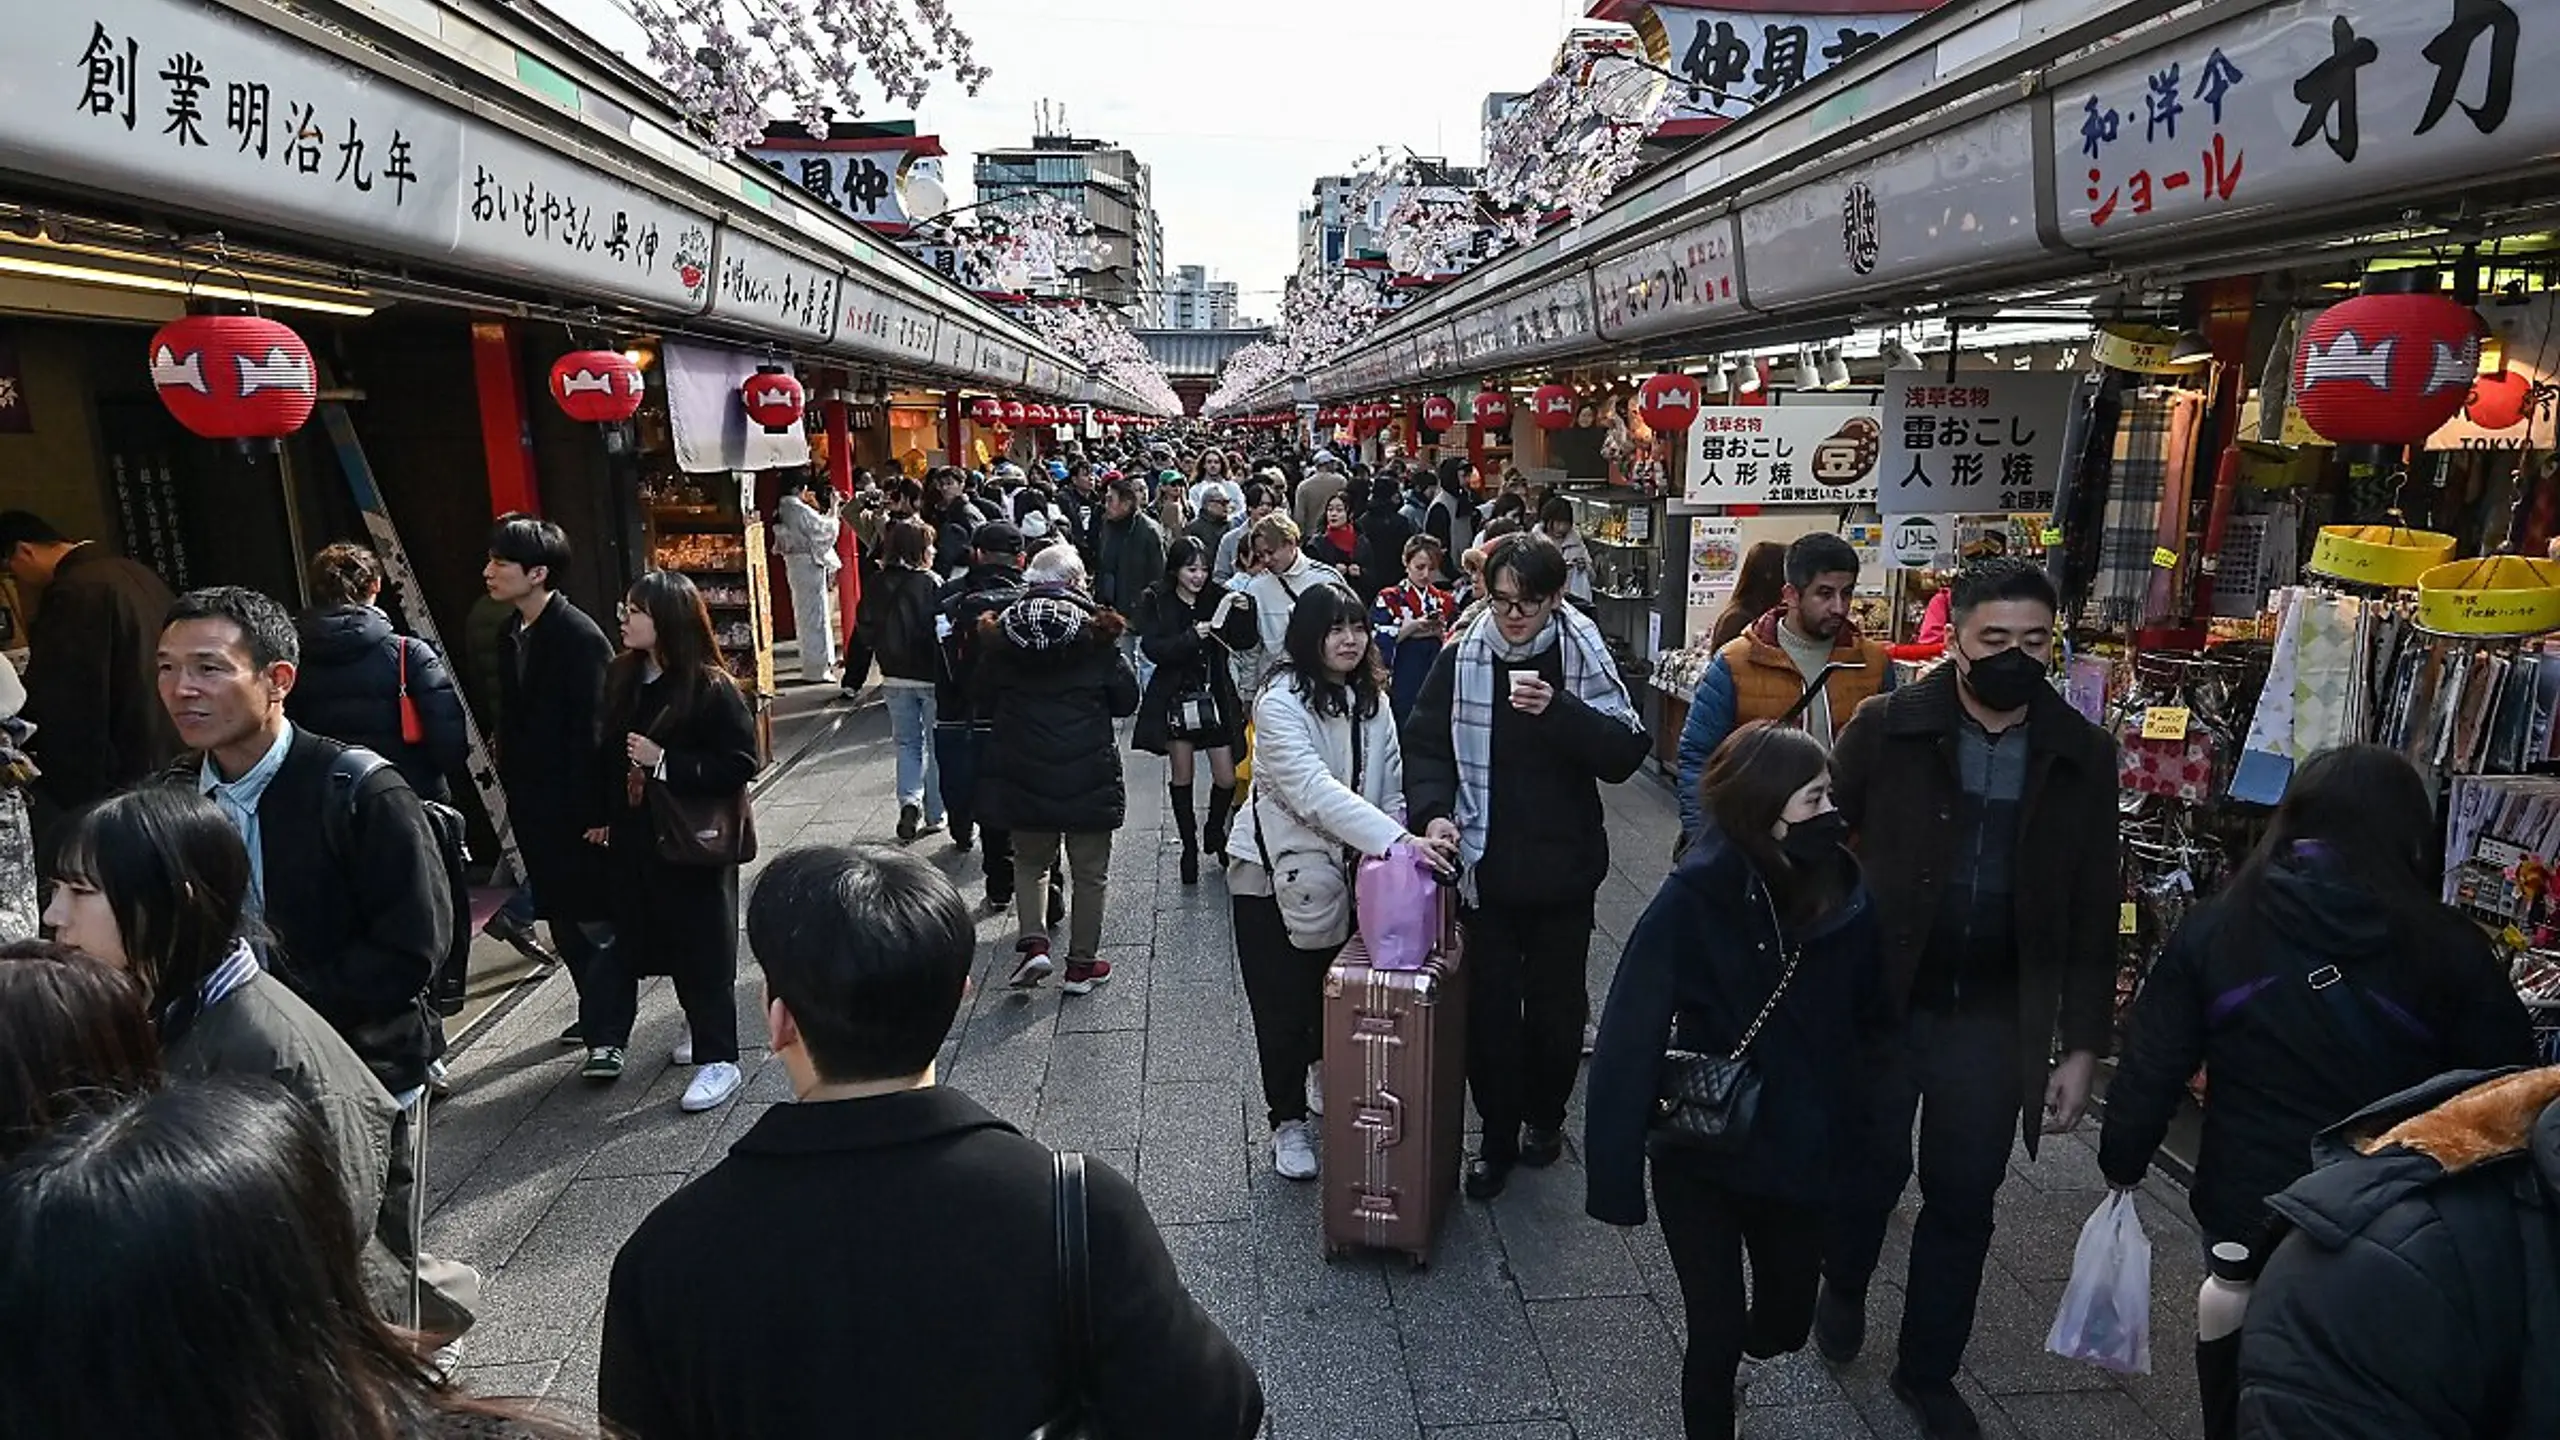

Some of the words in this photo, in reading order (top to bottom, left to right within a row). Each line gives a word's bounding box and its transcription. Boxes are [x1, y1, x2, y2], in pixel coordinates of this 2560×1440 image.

[76, 20, 417, 206] 創業明治九年
[2086, 133, 2244, 227] ショール
[471, 164, 597, 252] おいもやさん
[1905, 386, 1990, 409] 浅草名物
[1703, 416, 1763, 433] 浅草名物
[1903, 415, 2036, 449] 雷おこし
[1702, 436, 1794, 460] 雷おこし
[1816, 438, 1860, 477] 豆
[1700, 462, 1793, 486] 人形焼
[1899, 452, 2034, 488] 人形焼
